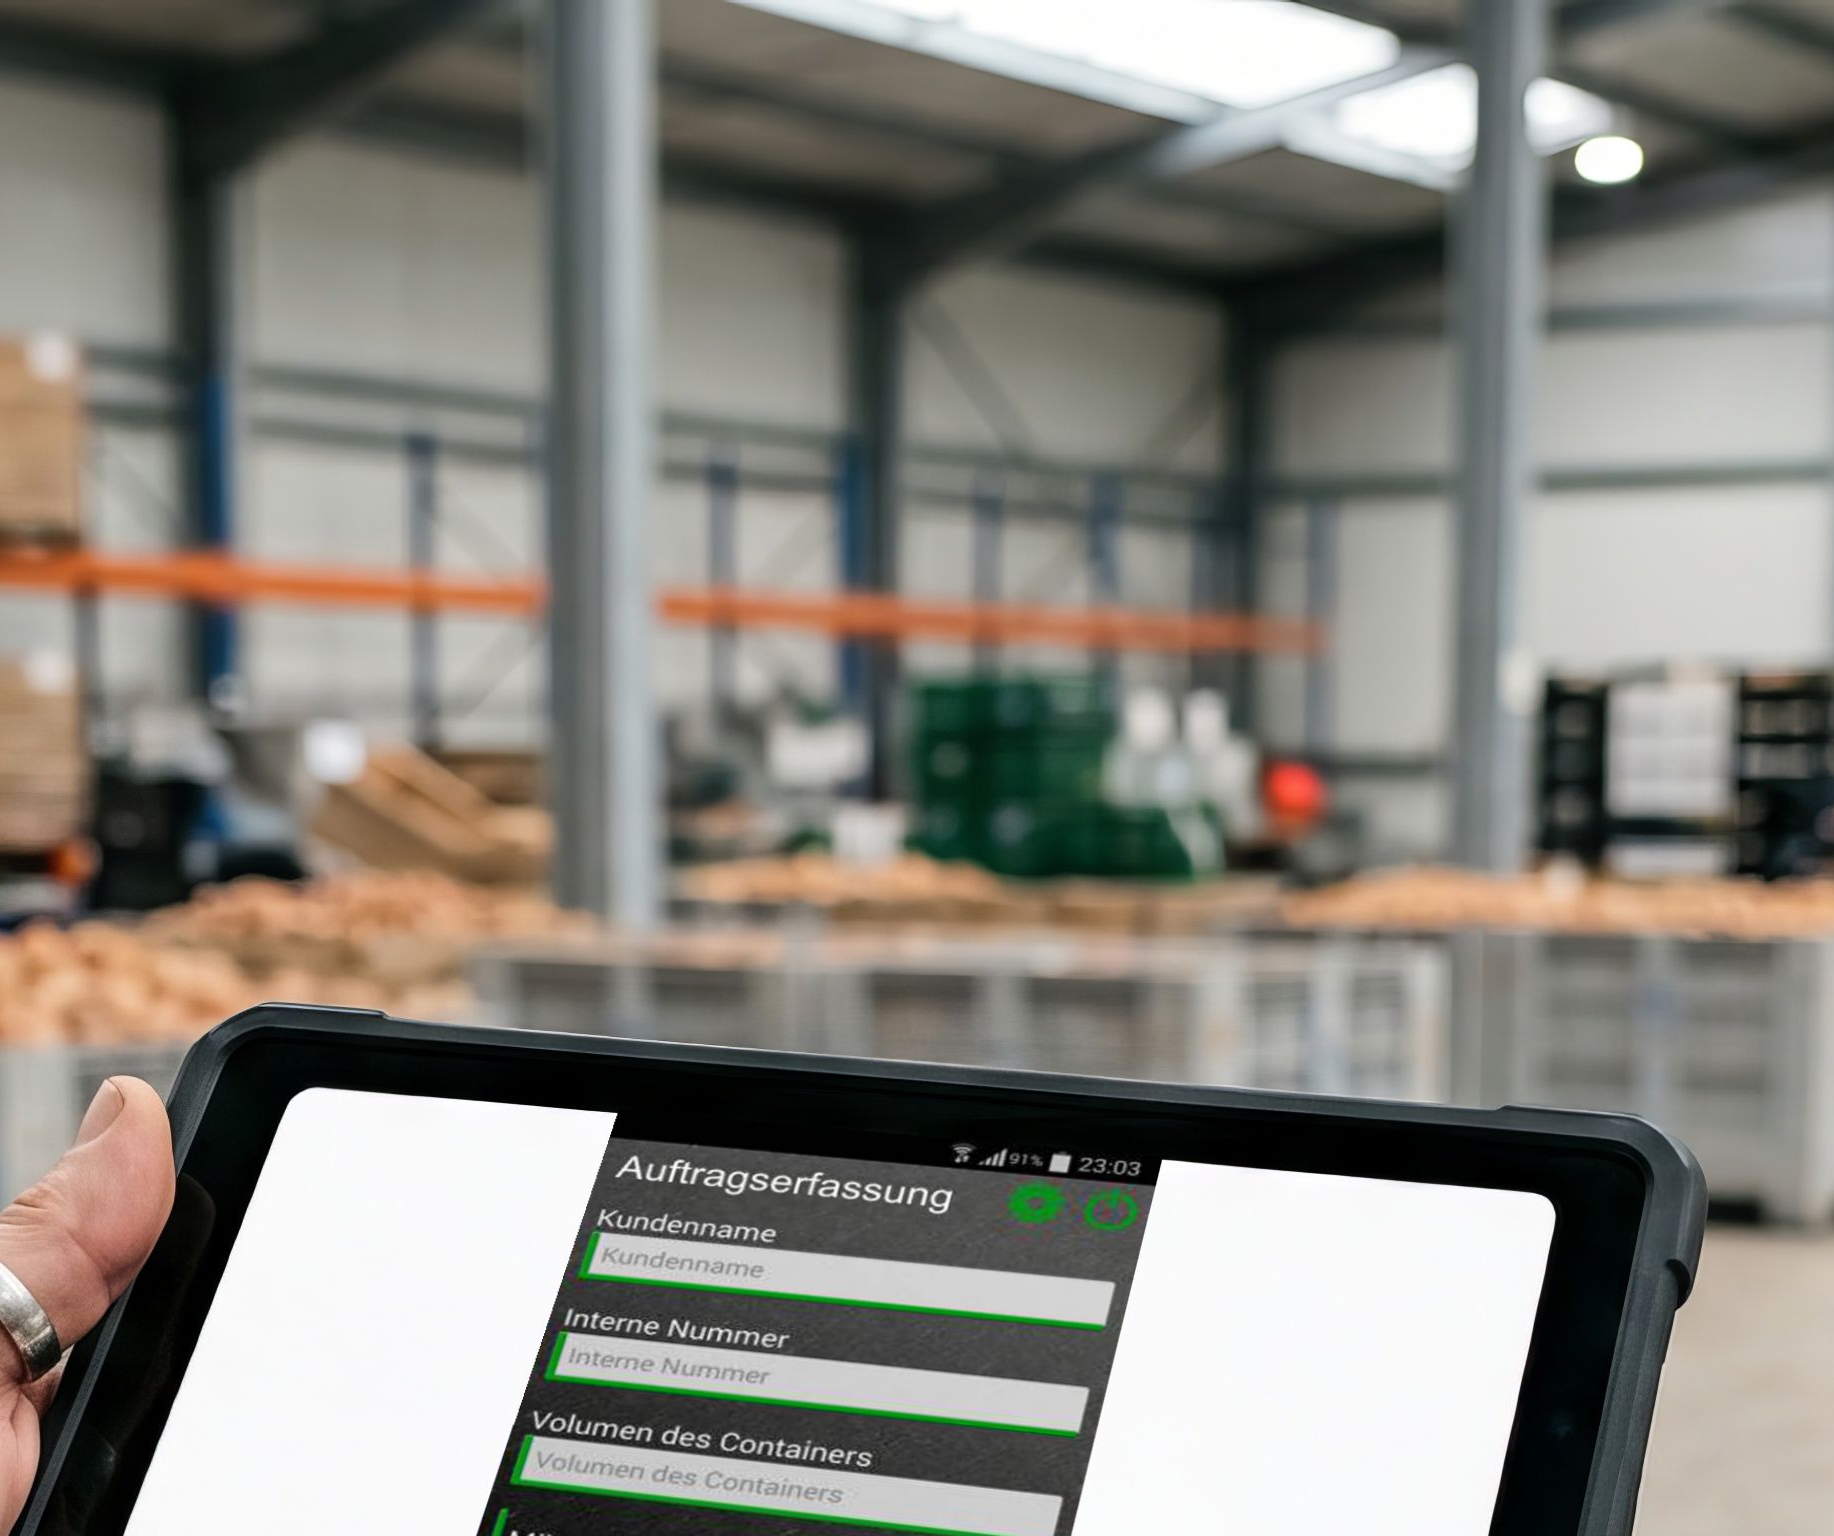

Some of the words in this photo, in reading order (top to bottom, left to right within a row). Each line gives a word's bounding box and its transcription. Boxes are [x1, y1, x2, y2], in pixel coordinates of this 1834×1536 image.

[1009, 1153, 1044, 1167] 91%
[1078, 1157, 1142, 1176] 23:03
[615, 1155, 953, 1215] Auftragserfassung
[596, 1208, 777, 1243] Kundenname
[600, 1247, 765, 1278] Kundenname
[563, 1308, 659, 1336] Interne
[666, 1318, 790, 1348] Nummer
[567, 1347, 655, 1372] Interne
[662, 1357, 772, 1385] Nummer
[532, 1410, 653, 1442] Volumen
[661, 1425, 711, 1449] des
[720, 1432, 873, 1467] Containers
[536, 1451, 644, 1479] Volumen
[651, 1464, 697, 1486] des
[704, 1471, 844, 1504] Containers
